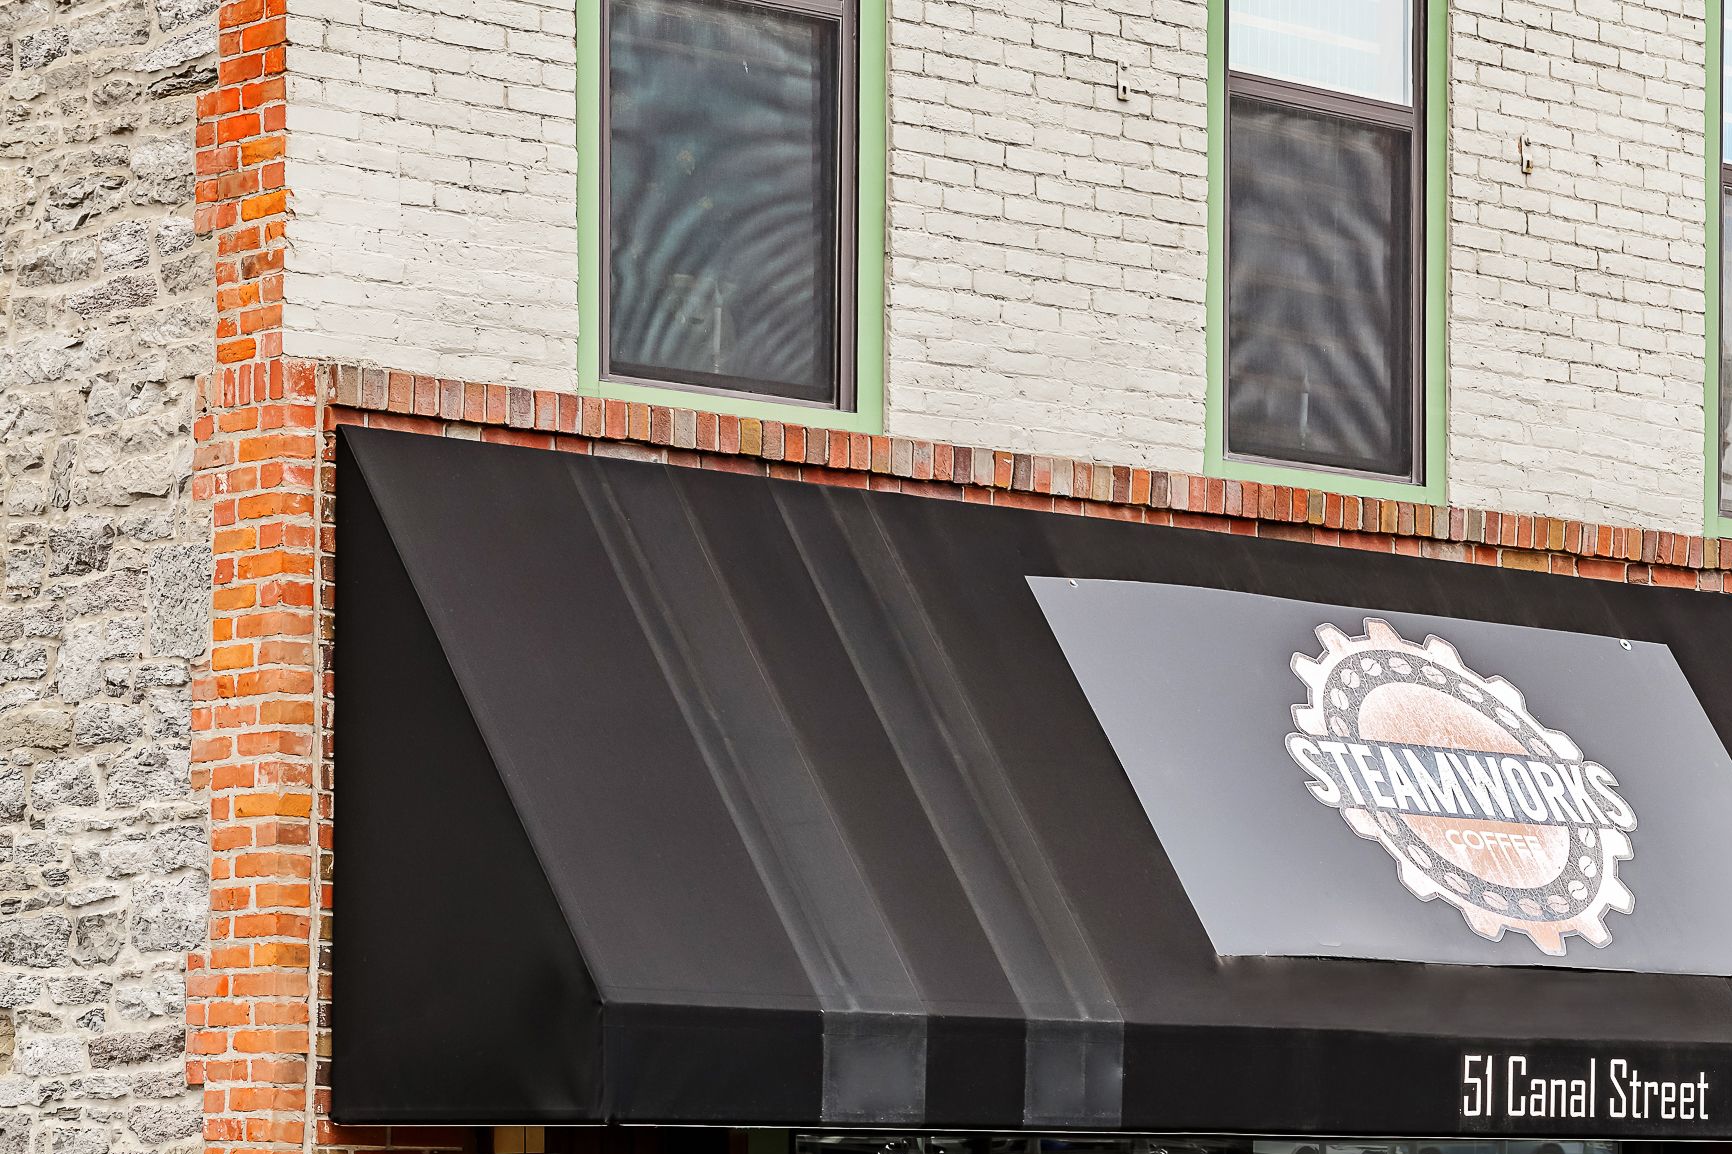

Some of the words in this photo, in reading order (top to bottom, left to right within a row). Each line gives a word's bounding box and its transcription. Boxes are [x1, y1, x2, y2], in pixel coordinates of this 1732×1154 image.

[1286, 733, 1637, 831] STEAMWORKS
[1445, 829, 1544, 857] COFFEE
[1462, 1054, 1493, 1117] 51
[1507, 1055, 1596, 1118] Canal
[1609, 1058, 1709, 1120] Street
